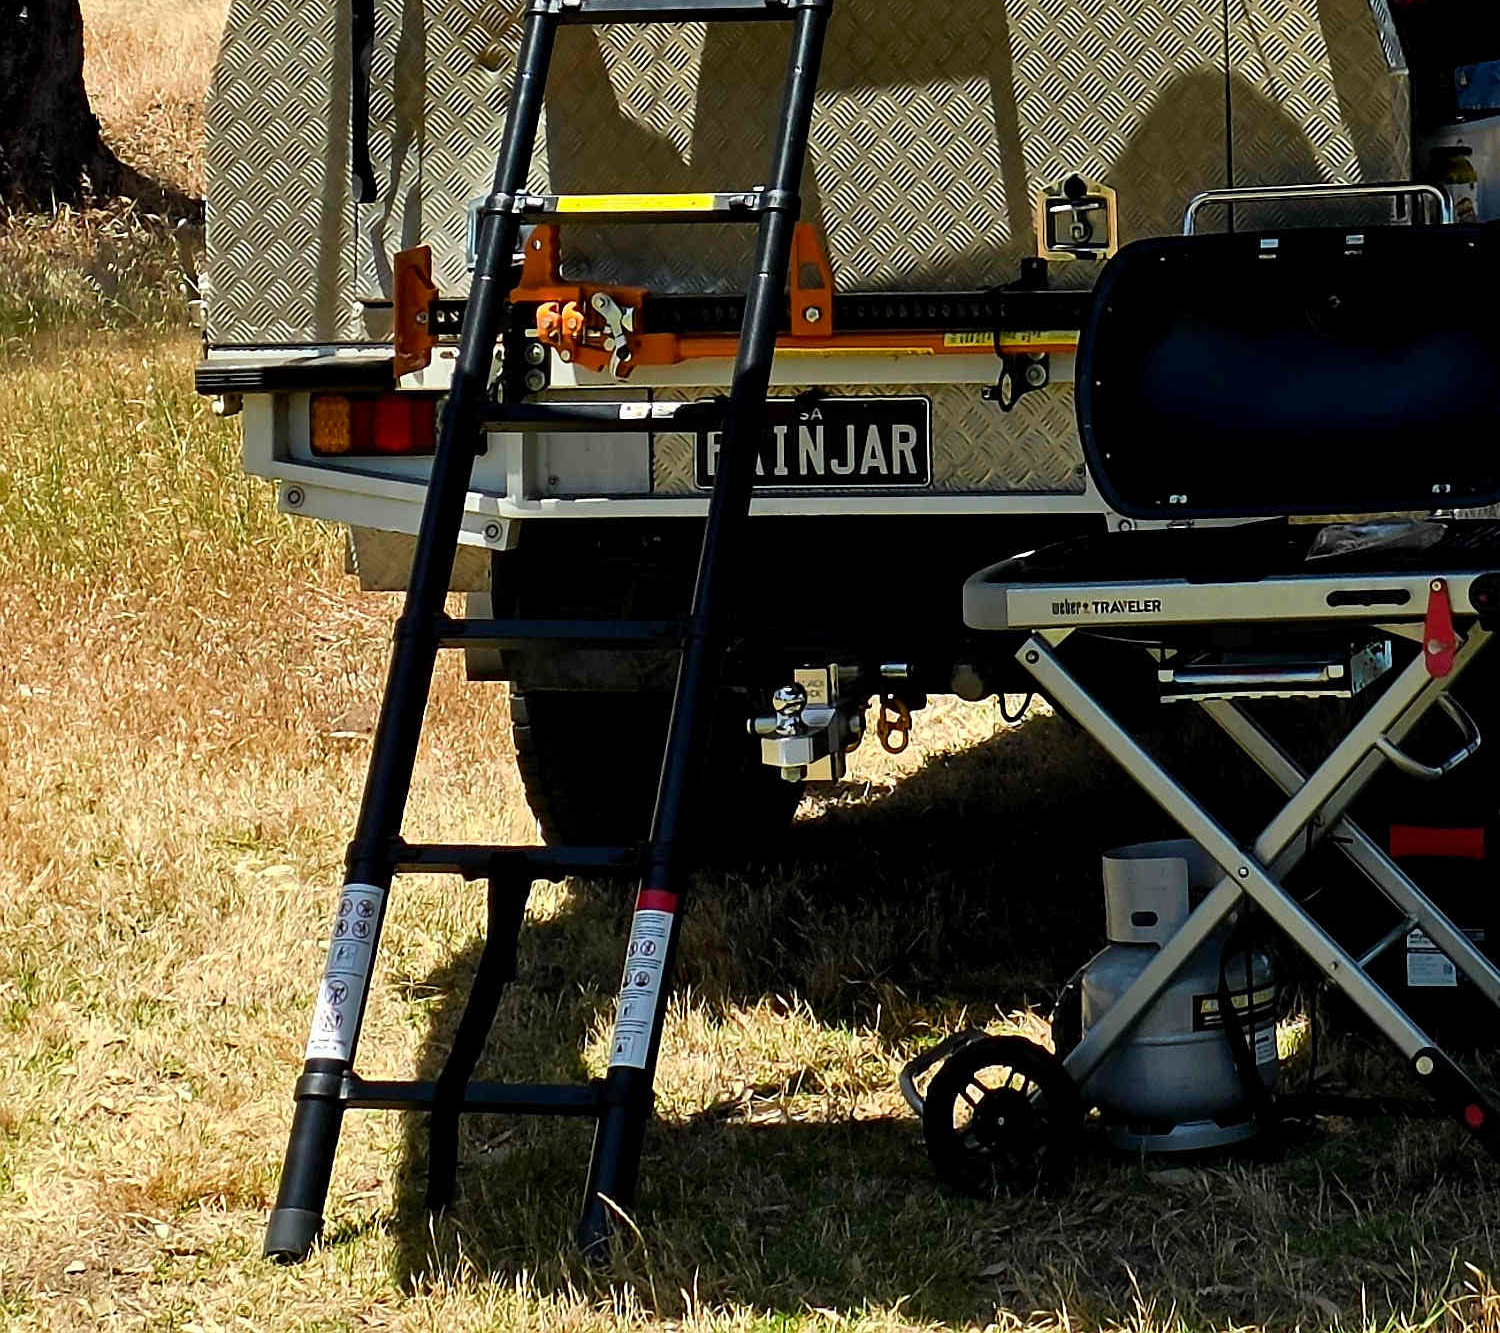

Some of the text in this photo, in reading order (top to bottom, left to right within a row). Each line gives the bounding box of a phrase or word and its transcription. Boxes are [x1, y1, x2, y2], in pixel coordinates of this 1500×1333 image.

[707, 424, 917, 476] INJAR
[1051, 599, 1162, 615] weber TRAVELER
